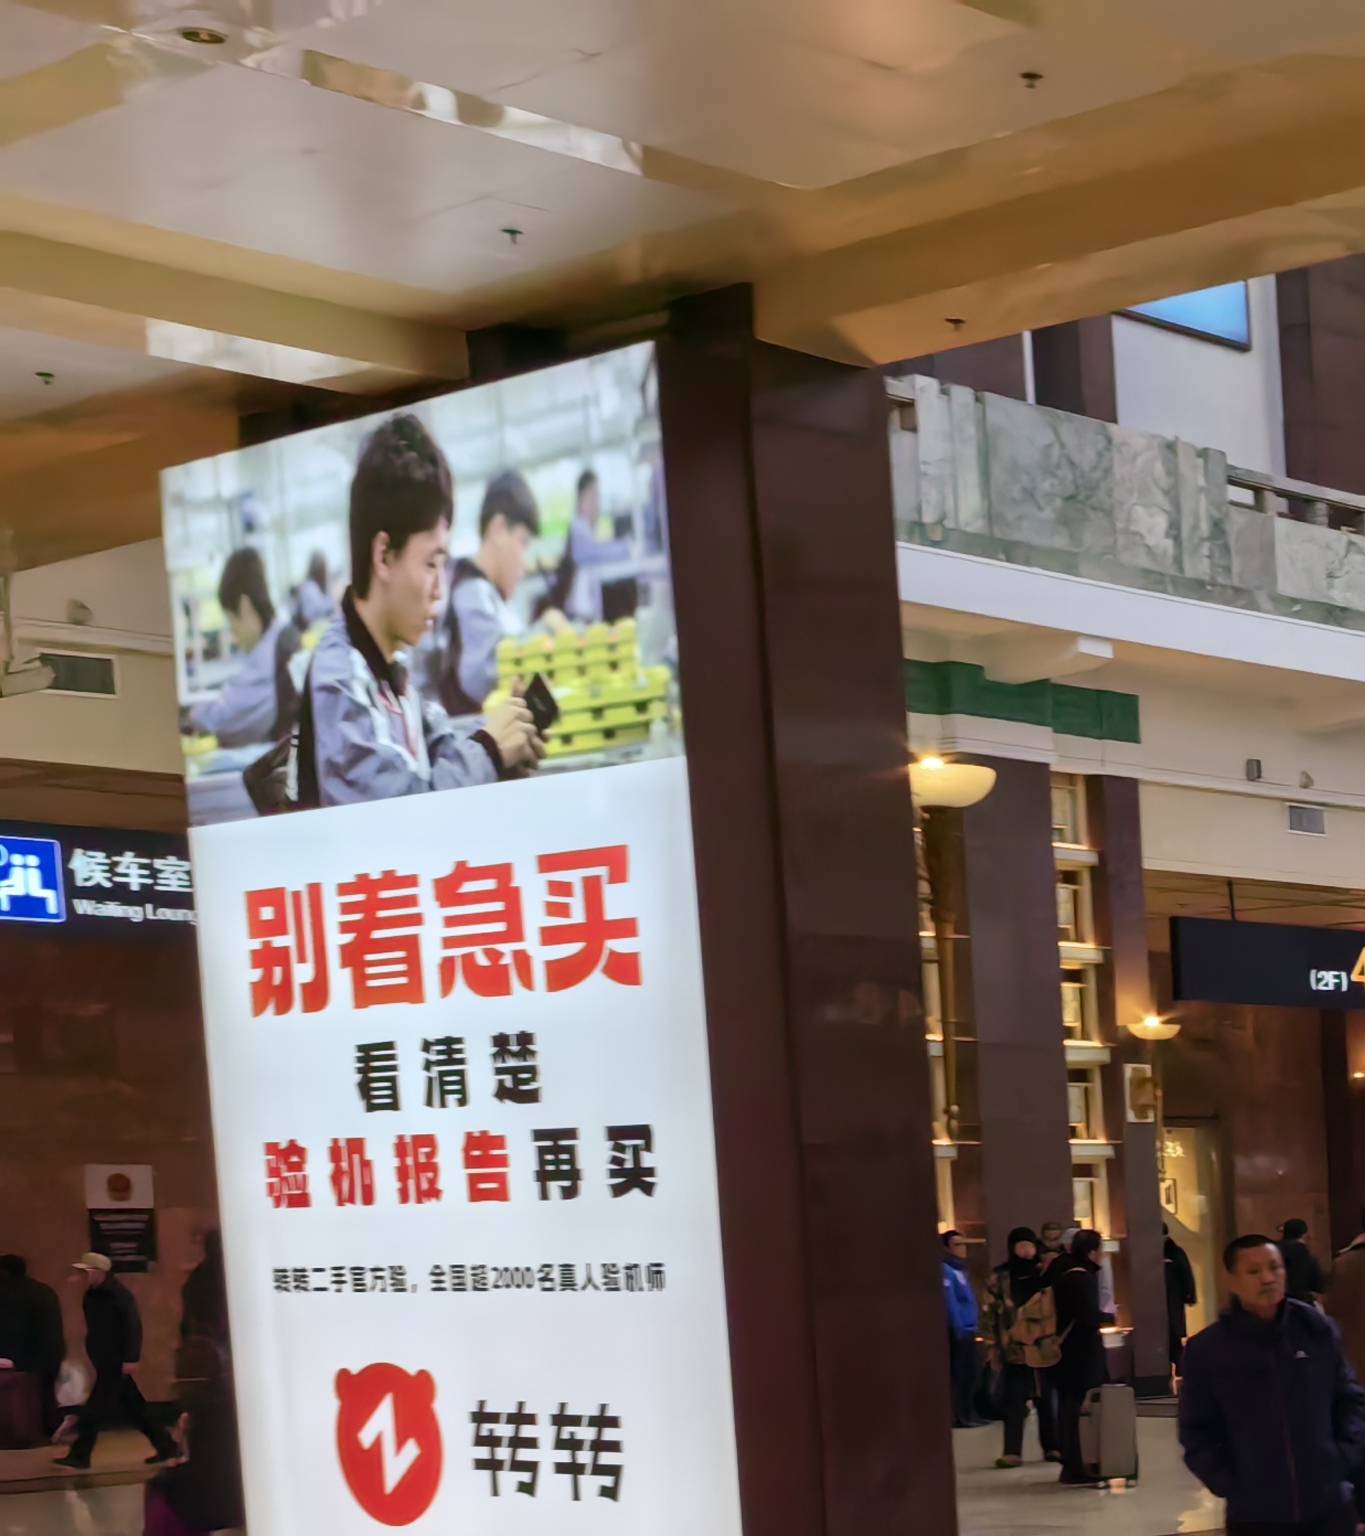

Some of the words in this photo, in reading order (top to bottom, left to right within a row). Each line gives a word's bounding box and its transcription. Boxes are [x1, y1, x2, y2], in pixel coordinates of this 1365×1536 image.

[67, 848, 194, 893] 候车室
[72, 898, 144, 923] Waiting
[244, 844, 643, 1017] 别着急买
[1309, 968, 1348, 993] (2F)
[354, 1031, 542, 1113] 看清楚
[263, 1123, 657, 1209] 验机报告再买
[470, 1400, 625, 1503] 转转
